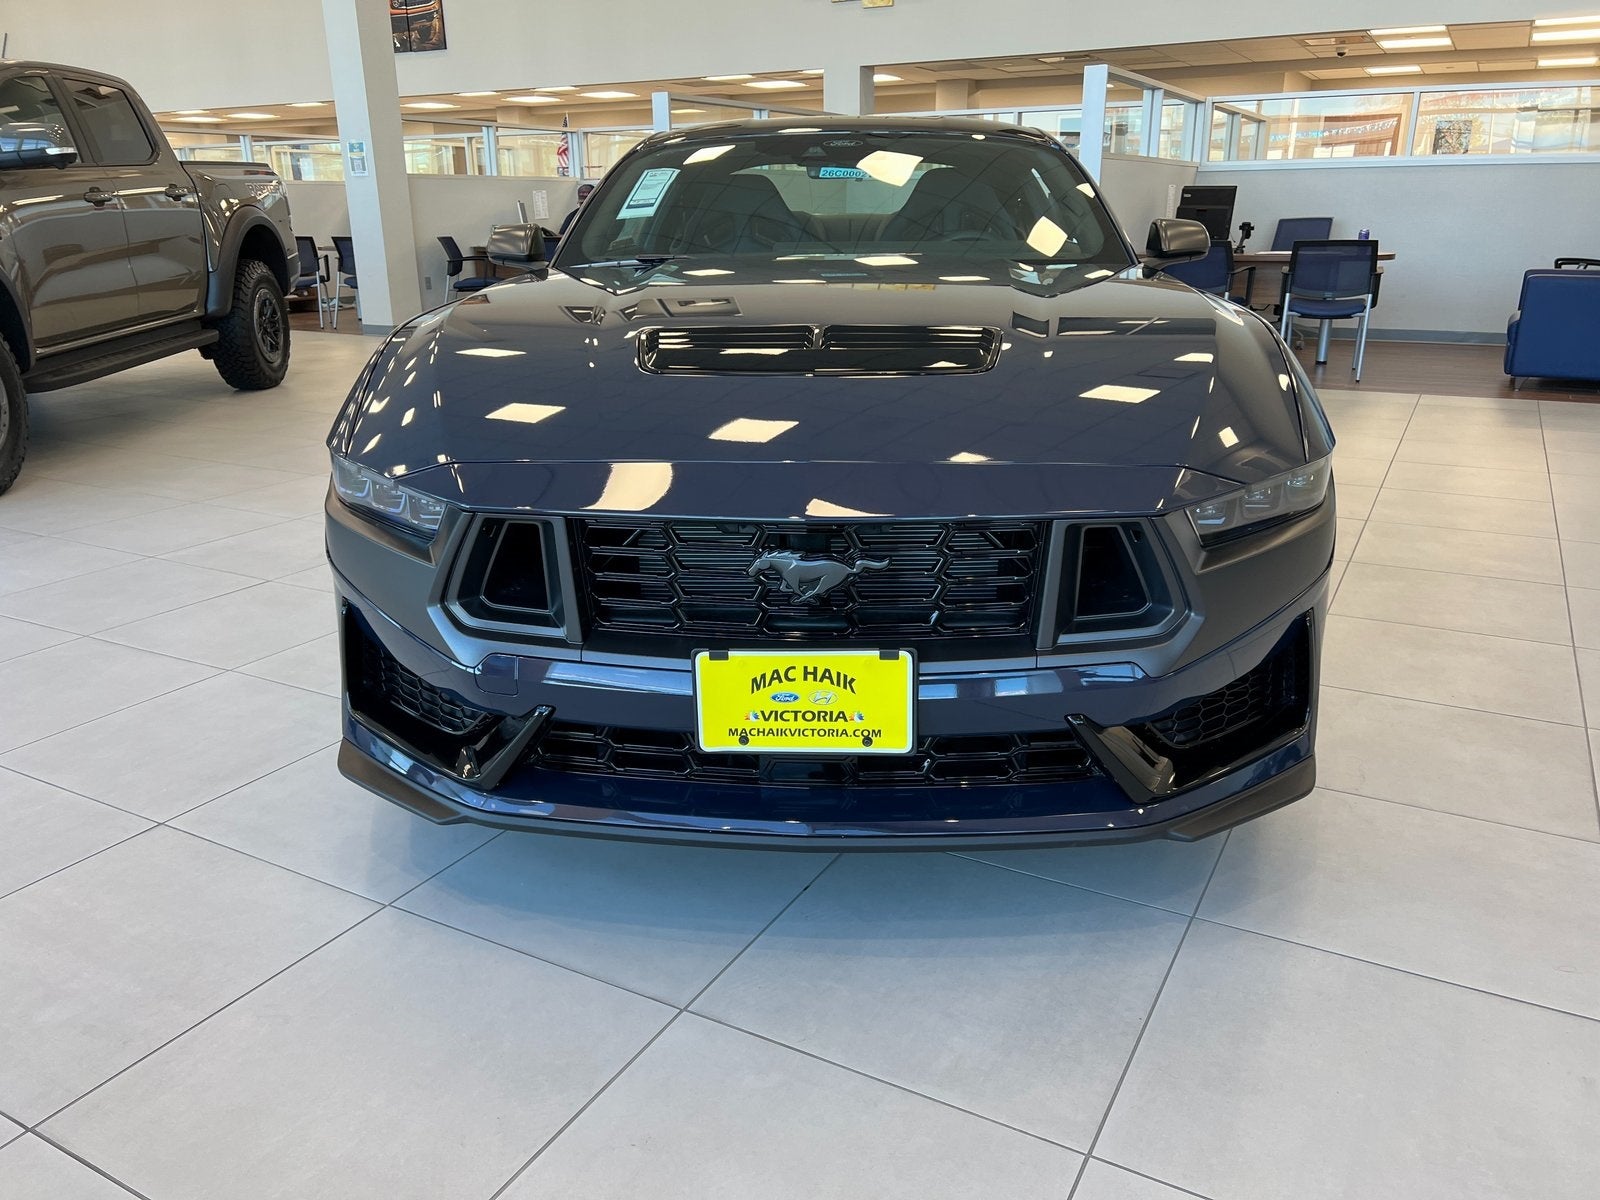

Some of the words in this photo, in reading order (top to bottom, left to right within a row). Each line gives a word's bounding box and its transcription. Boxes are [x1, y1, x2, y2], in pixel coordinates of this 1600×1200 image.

[751, 666, 797, 694] MAC
[803, 666, 856, 694] HAIK
[773, 693, 797, 702] Ford
[760, 710, 849, 722] VICTORIA
[728, 727, 882, 738] MACHAIKVICTORIA.COM
